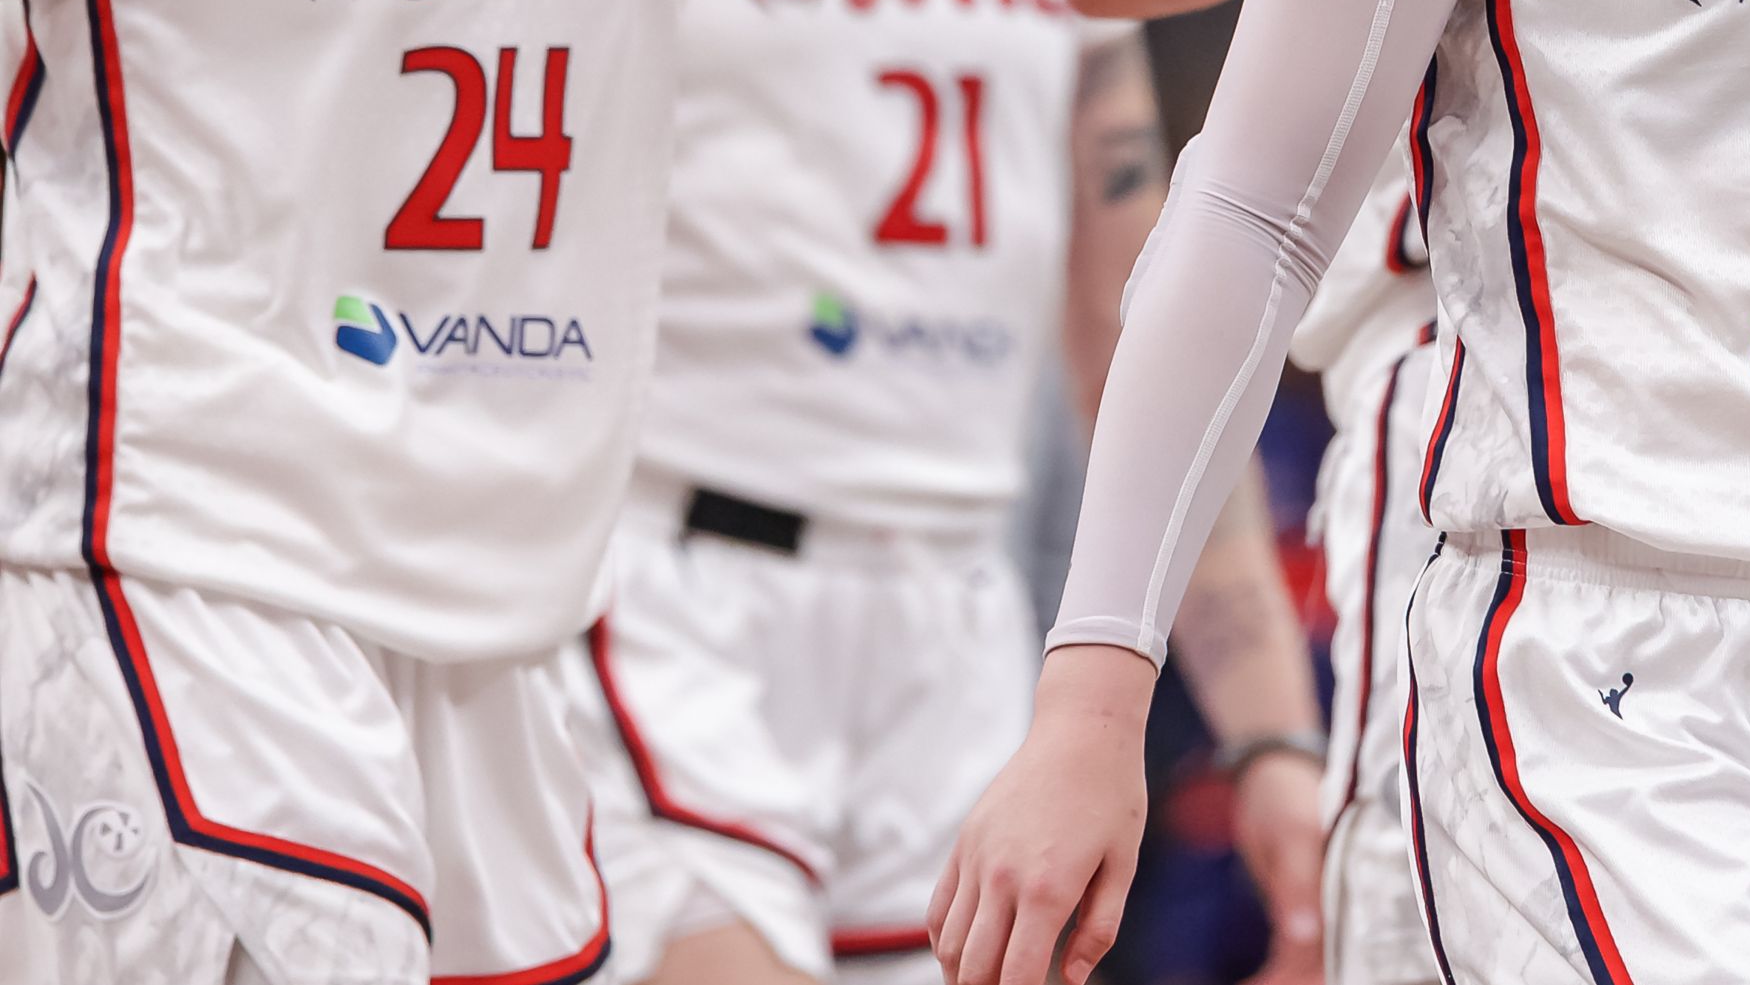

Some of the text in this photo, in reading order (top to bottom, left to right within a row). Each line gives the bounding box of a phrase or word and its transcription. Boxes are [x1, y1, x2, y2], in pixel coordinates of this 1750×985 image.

[384, 45, 572, 251] 24
[873, 69, 990, 247] 21
[397, 312, 592, 361] VANDA
